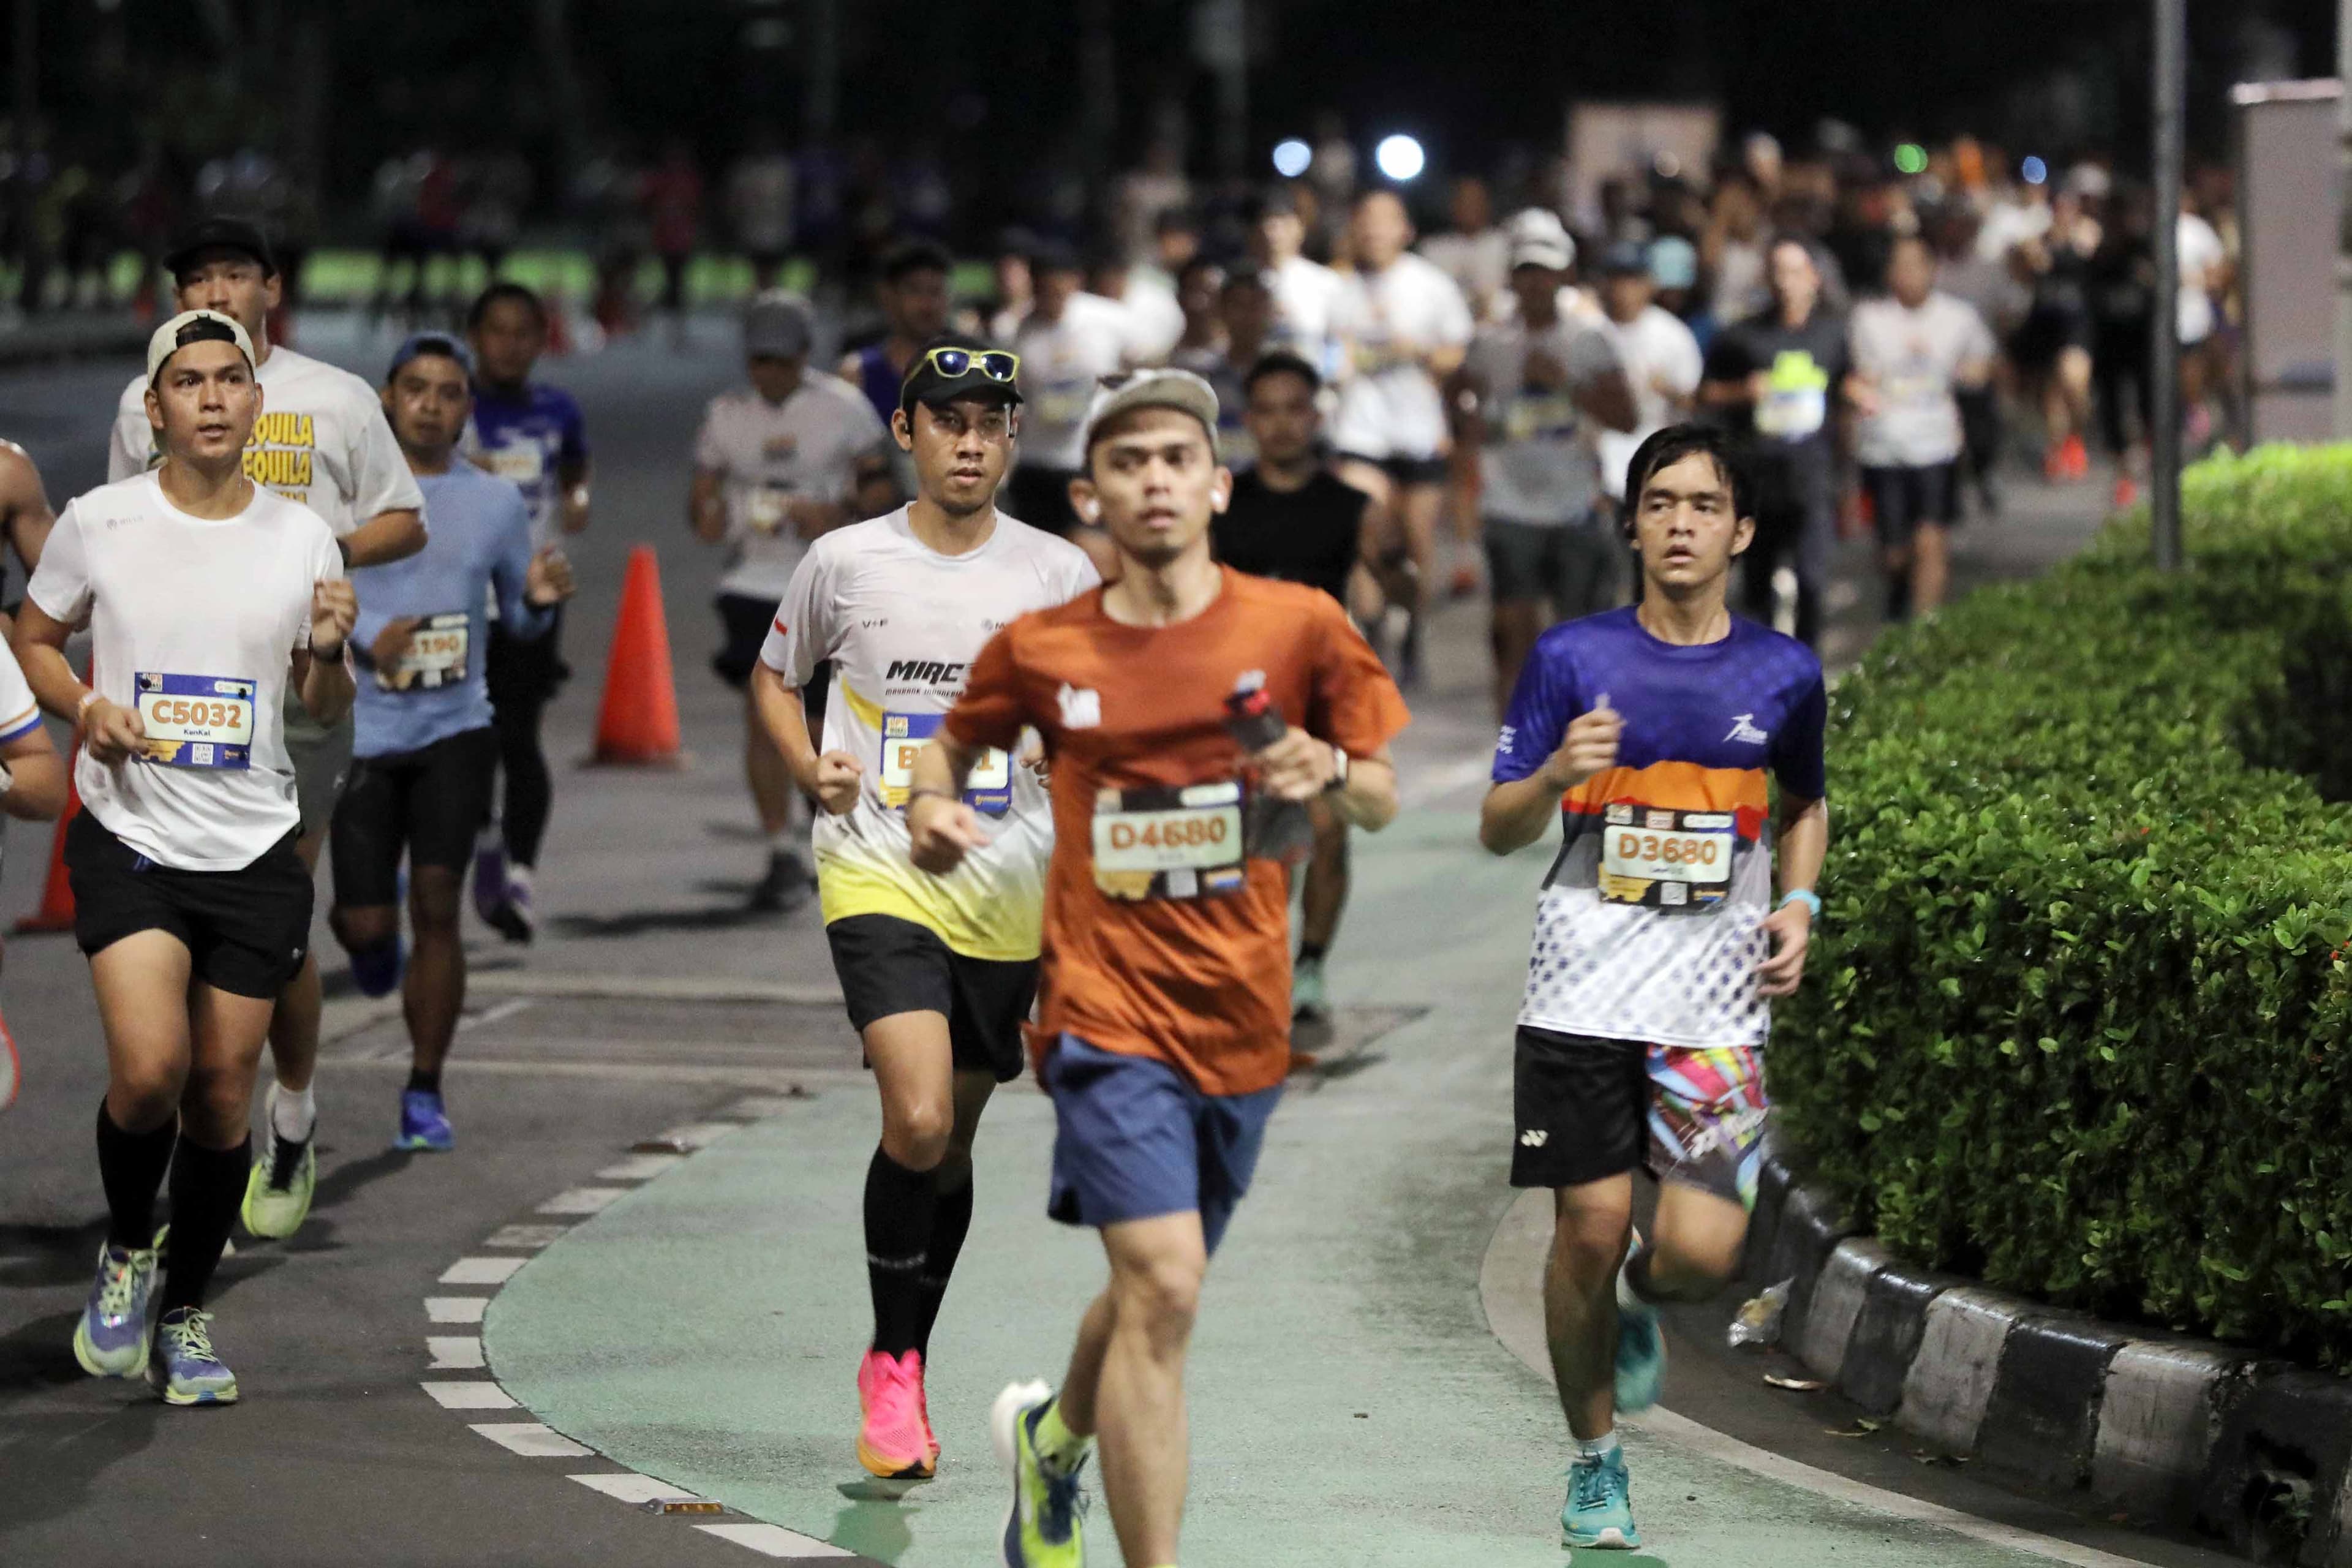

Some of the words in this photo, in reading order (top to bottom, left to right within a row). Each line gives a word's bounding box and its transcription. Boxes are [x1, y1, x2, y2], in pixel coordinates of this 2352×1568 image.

[246, 413, 314, 448] QUILA
[151, 699, 242, 729] C5032
[1110, 815, 1227, 851] D4680
[1618, 832, 1718, 865] D3680
